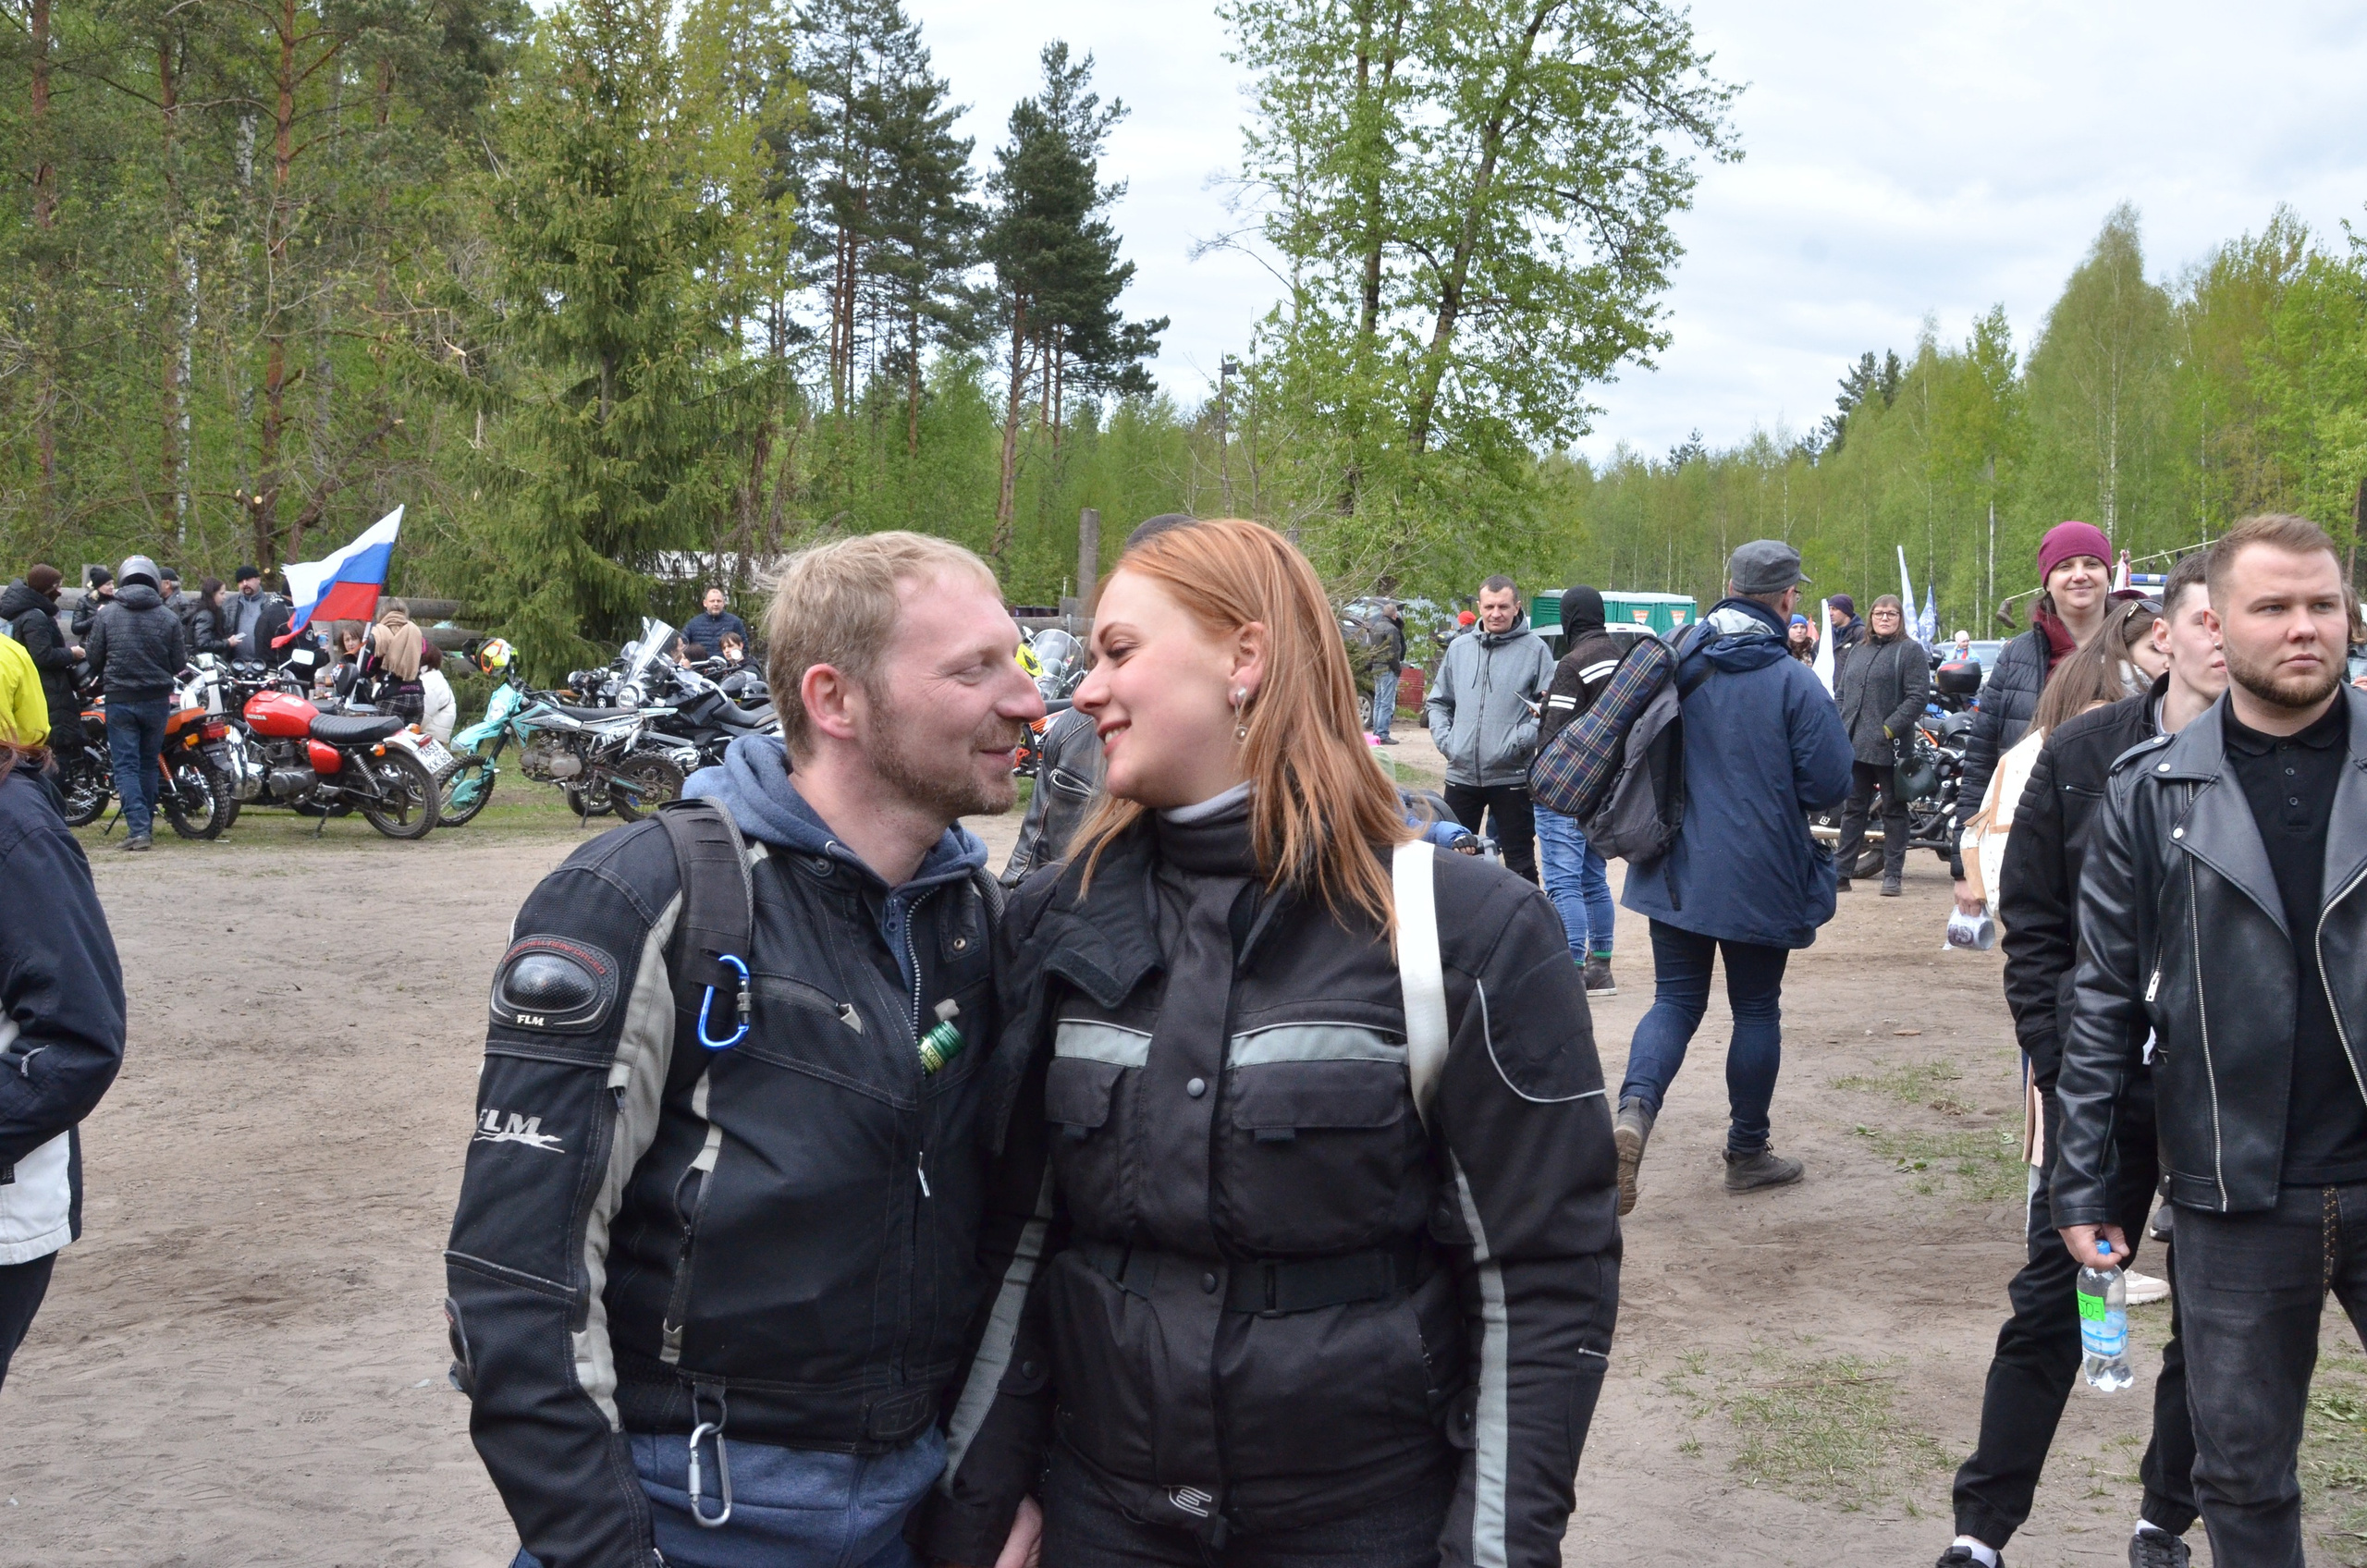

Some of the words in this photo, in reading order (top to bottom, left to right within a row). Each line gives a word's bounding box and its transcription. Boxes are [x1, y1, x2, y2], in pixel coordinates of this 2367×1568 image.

[246, 713, 267, 721] HONDA
[420, 741, 439, 759] 1653
[547, 940, 607, 975] REINFORCED
[517, 1013, 546, 1027] FLM
